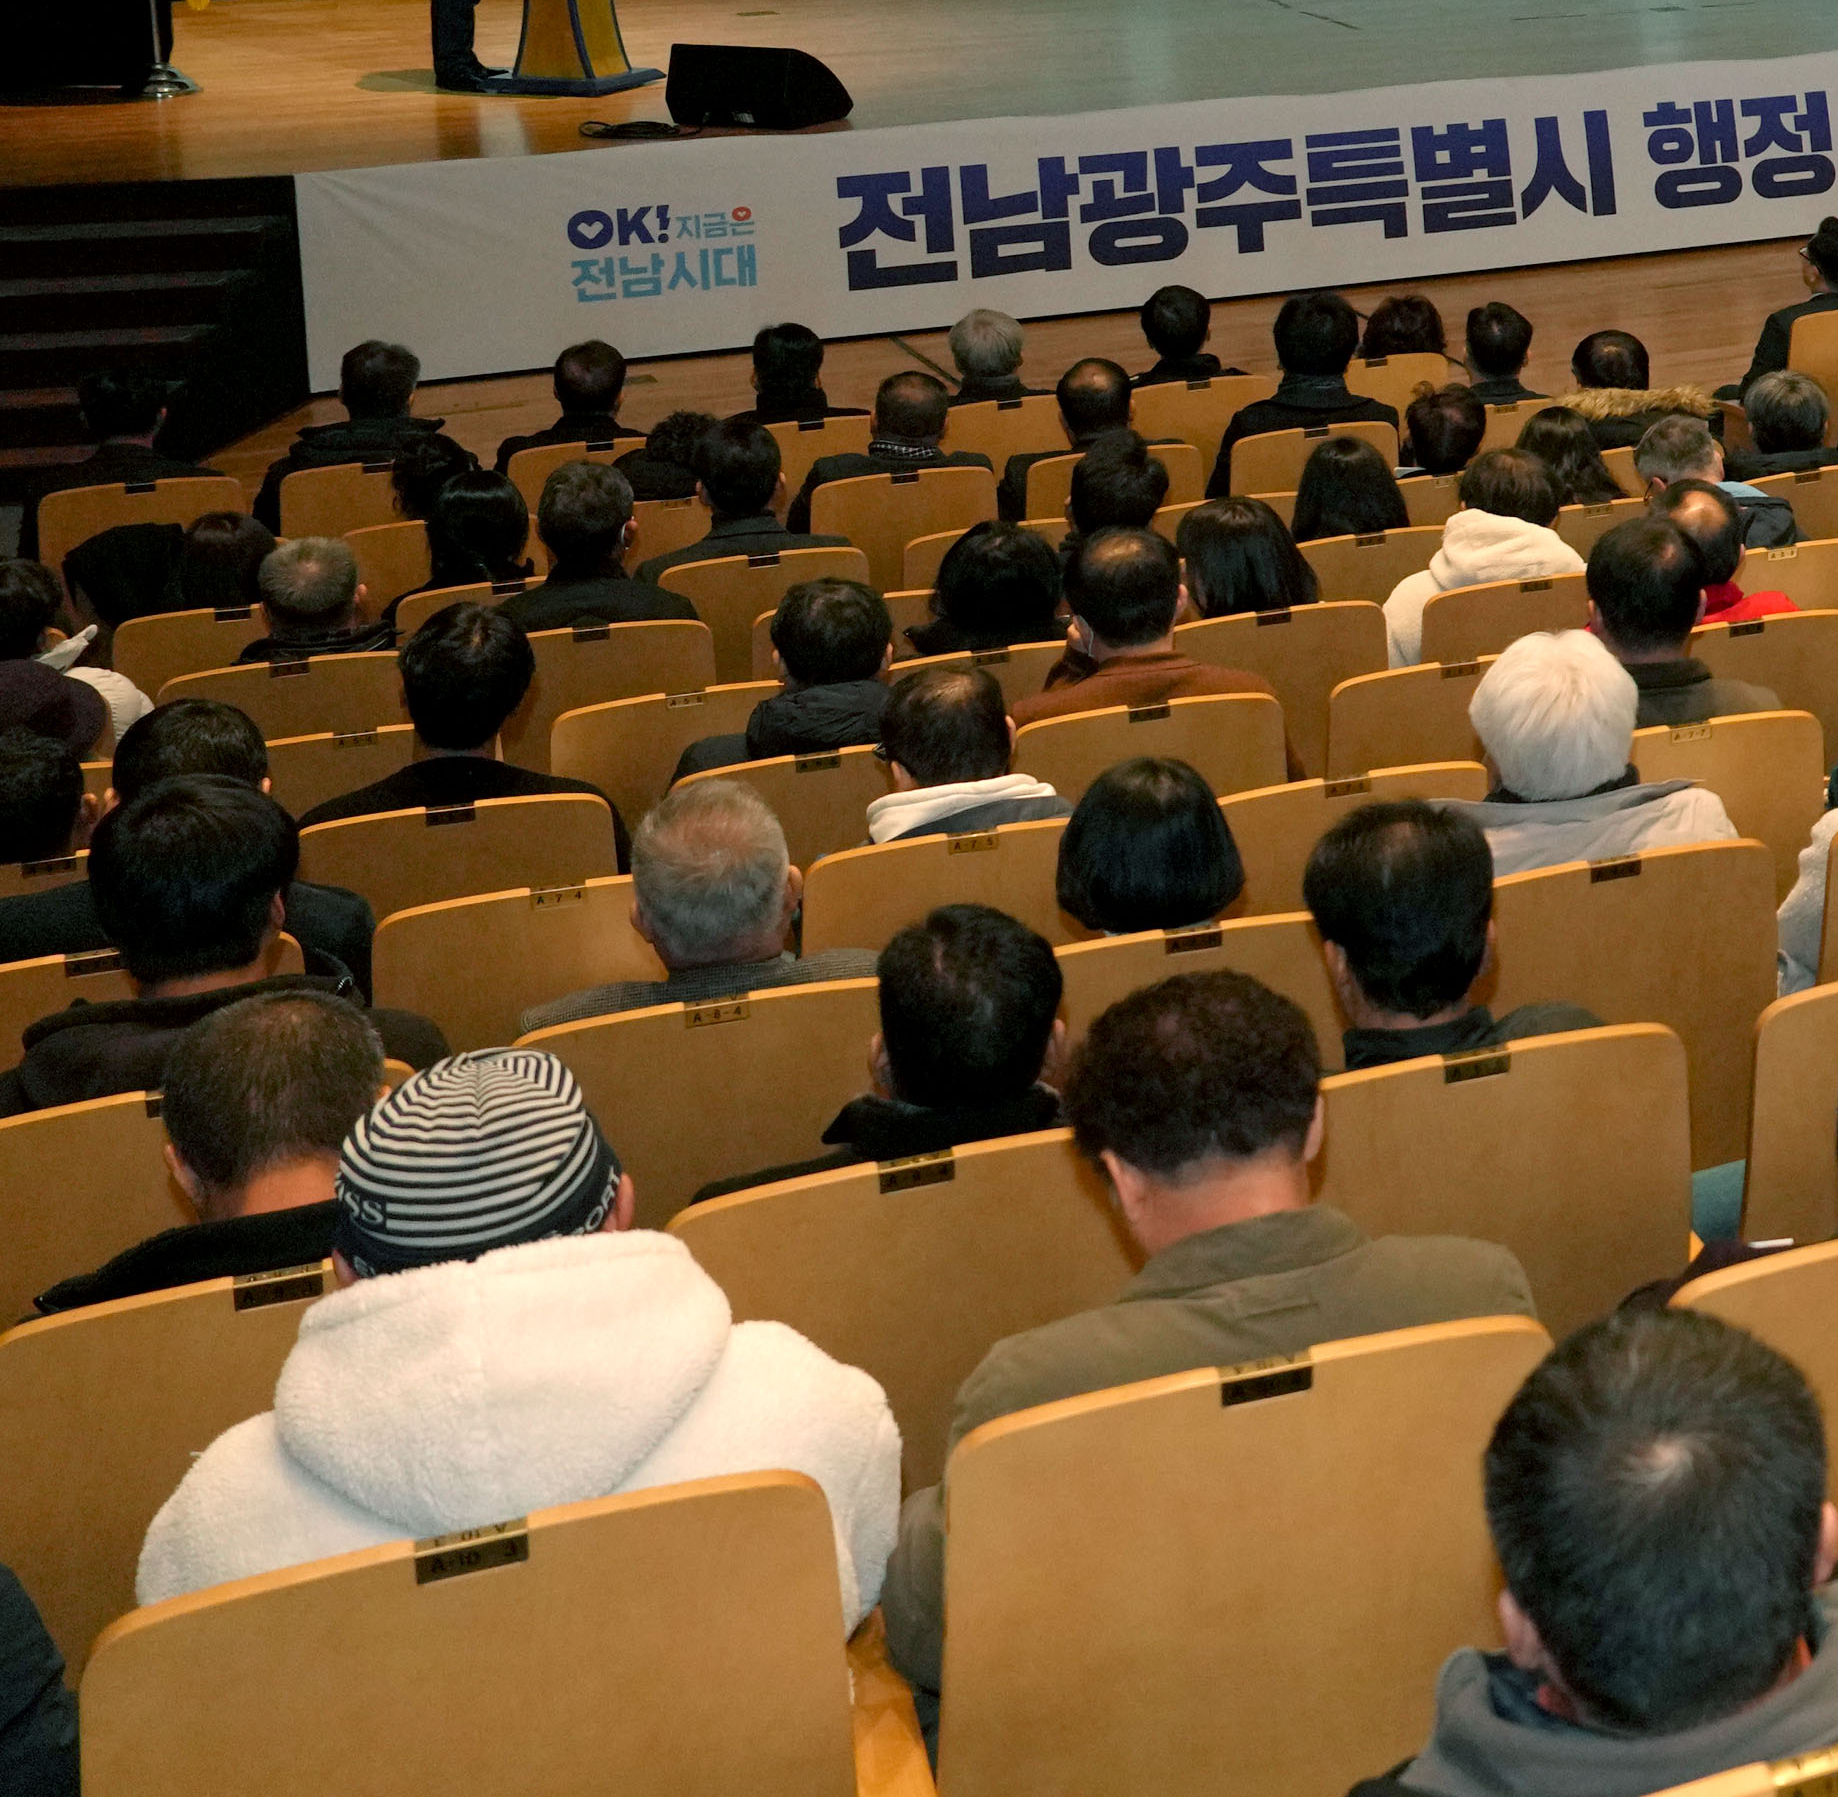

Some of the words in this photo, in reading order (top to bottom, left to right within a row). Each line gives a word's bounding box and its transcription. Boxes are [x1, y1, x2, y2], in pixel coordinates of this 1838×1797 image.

[567, 203, 669, 250] OK!
[676, 206, 756, 241] 지금은
[836, 107, 1618, 292] 전남광주특별시
[569, 242, 759, 304] 전남시대
